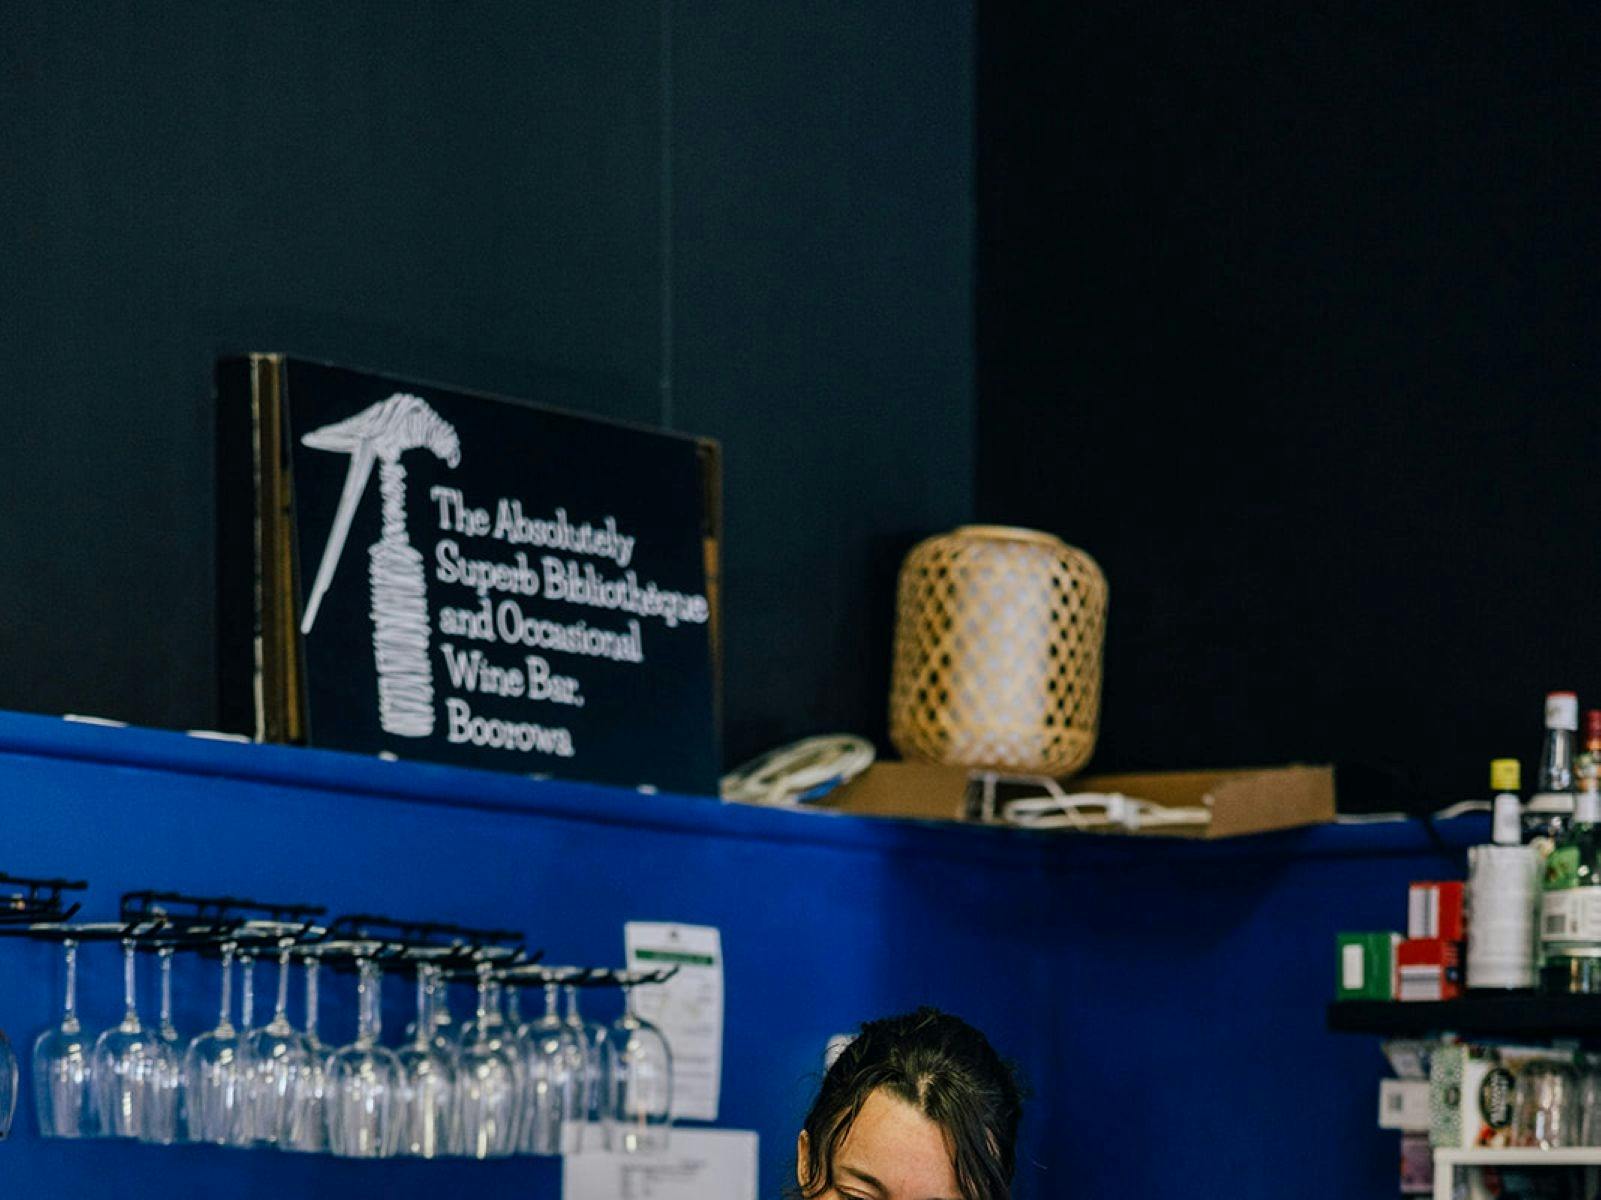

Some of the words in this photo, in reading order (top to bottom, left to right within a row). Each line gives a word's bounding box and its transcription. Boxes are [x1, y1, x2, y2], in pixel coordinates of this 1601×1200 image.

[430, 486, 490, 536] The
[494, 498, 635, 567] Absolutely
[436, 539, 540, 596] Superb
[439, 598, 495, 642] and
[497, 600, 644, 663] Occasional
[440, 643, 525, 697] Wine
[445, 697, 575, 757] Boorowa
